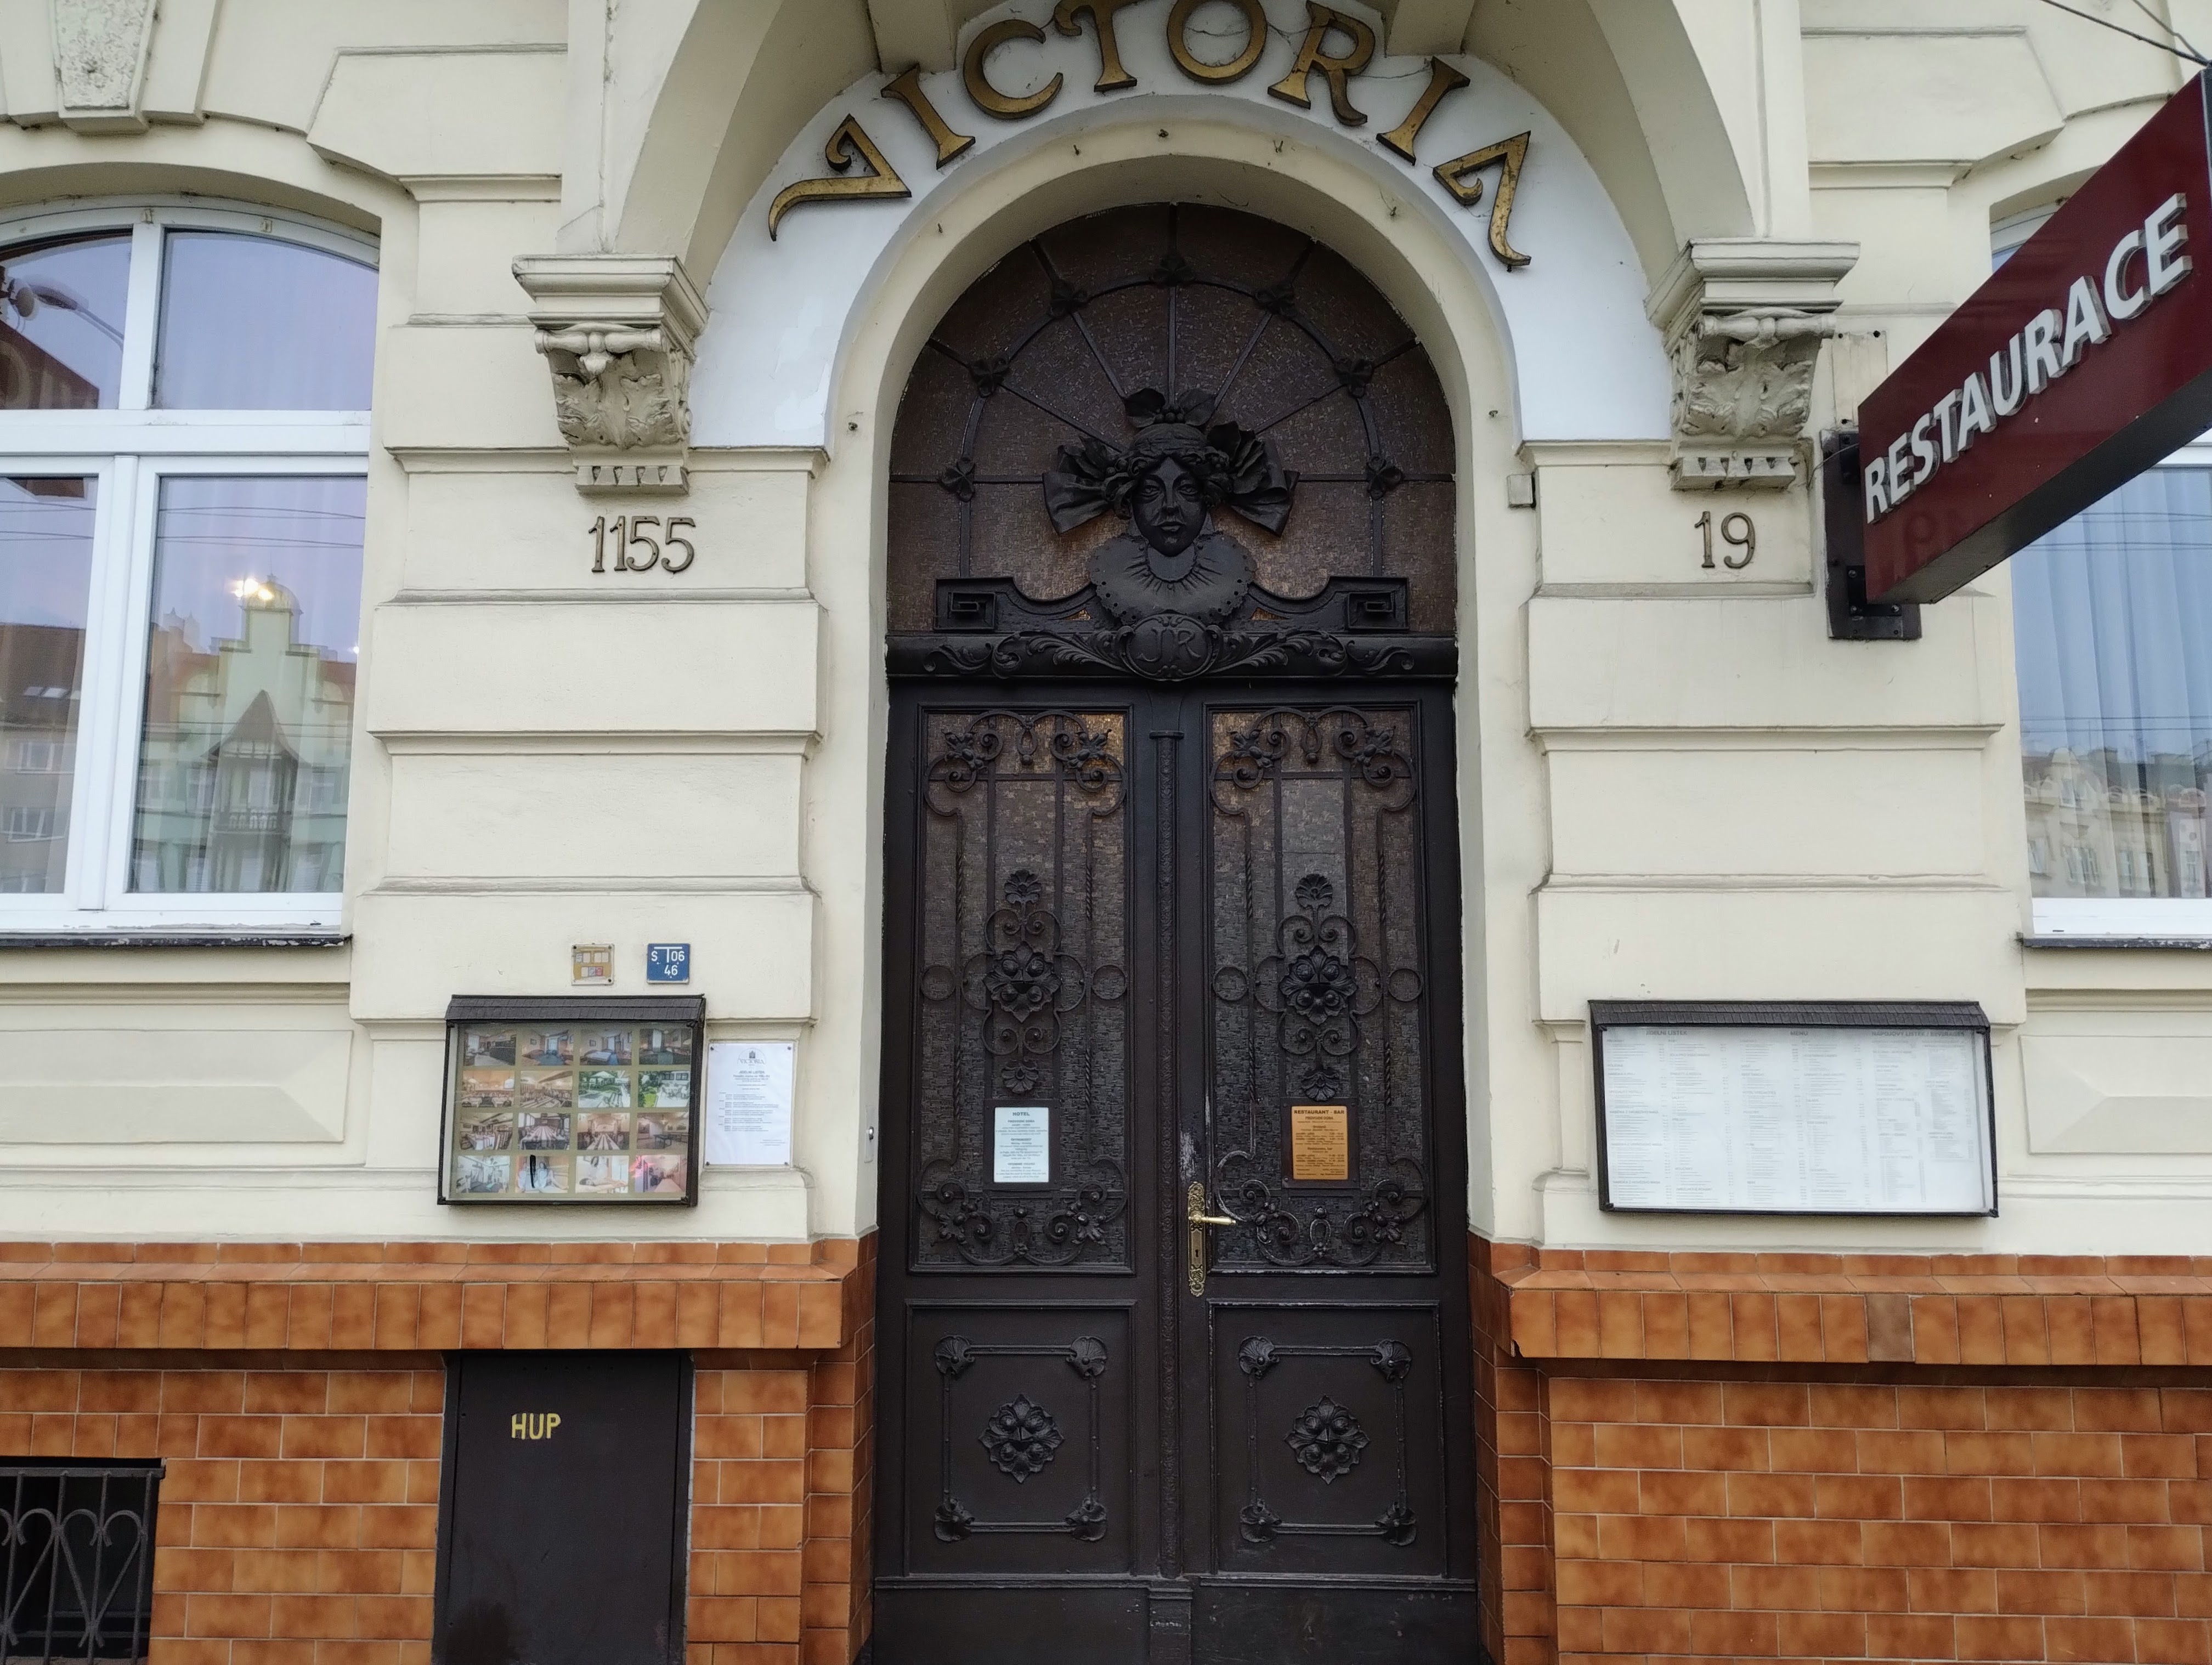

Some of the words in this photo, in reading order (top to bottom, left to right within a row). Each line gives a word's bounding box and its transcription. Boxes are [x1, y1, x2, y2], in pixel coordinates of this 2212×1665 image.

[768, 0, 1532, 267] VICTORIA
[1864, 192, 2193, 524] RESTAURACE
[589, 515, 696, 574] 1155
[1694, 511, 1756, 569] 19
[511, 1413, 561, 1440] HUP
